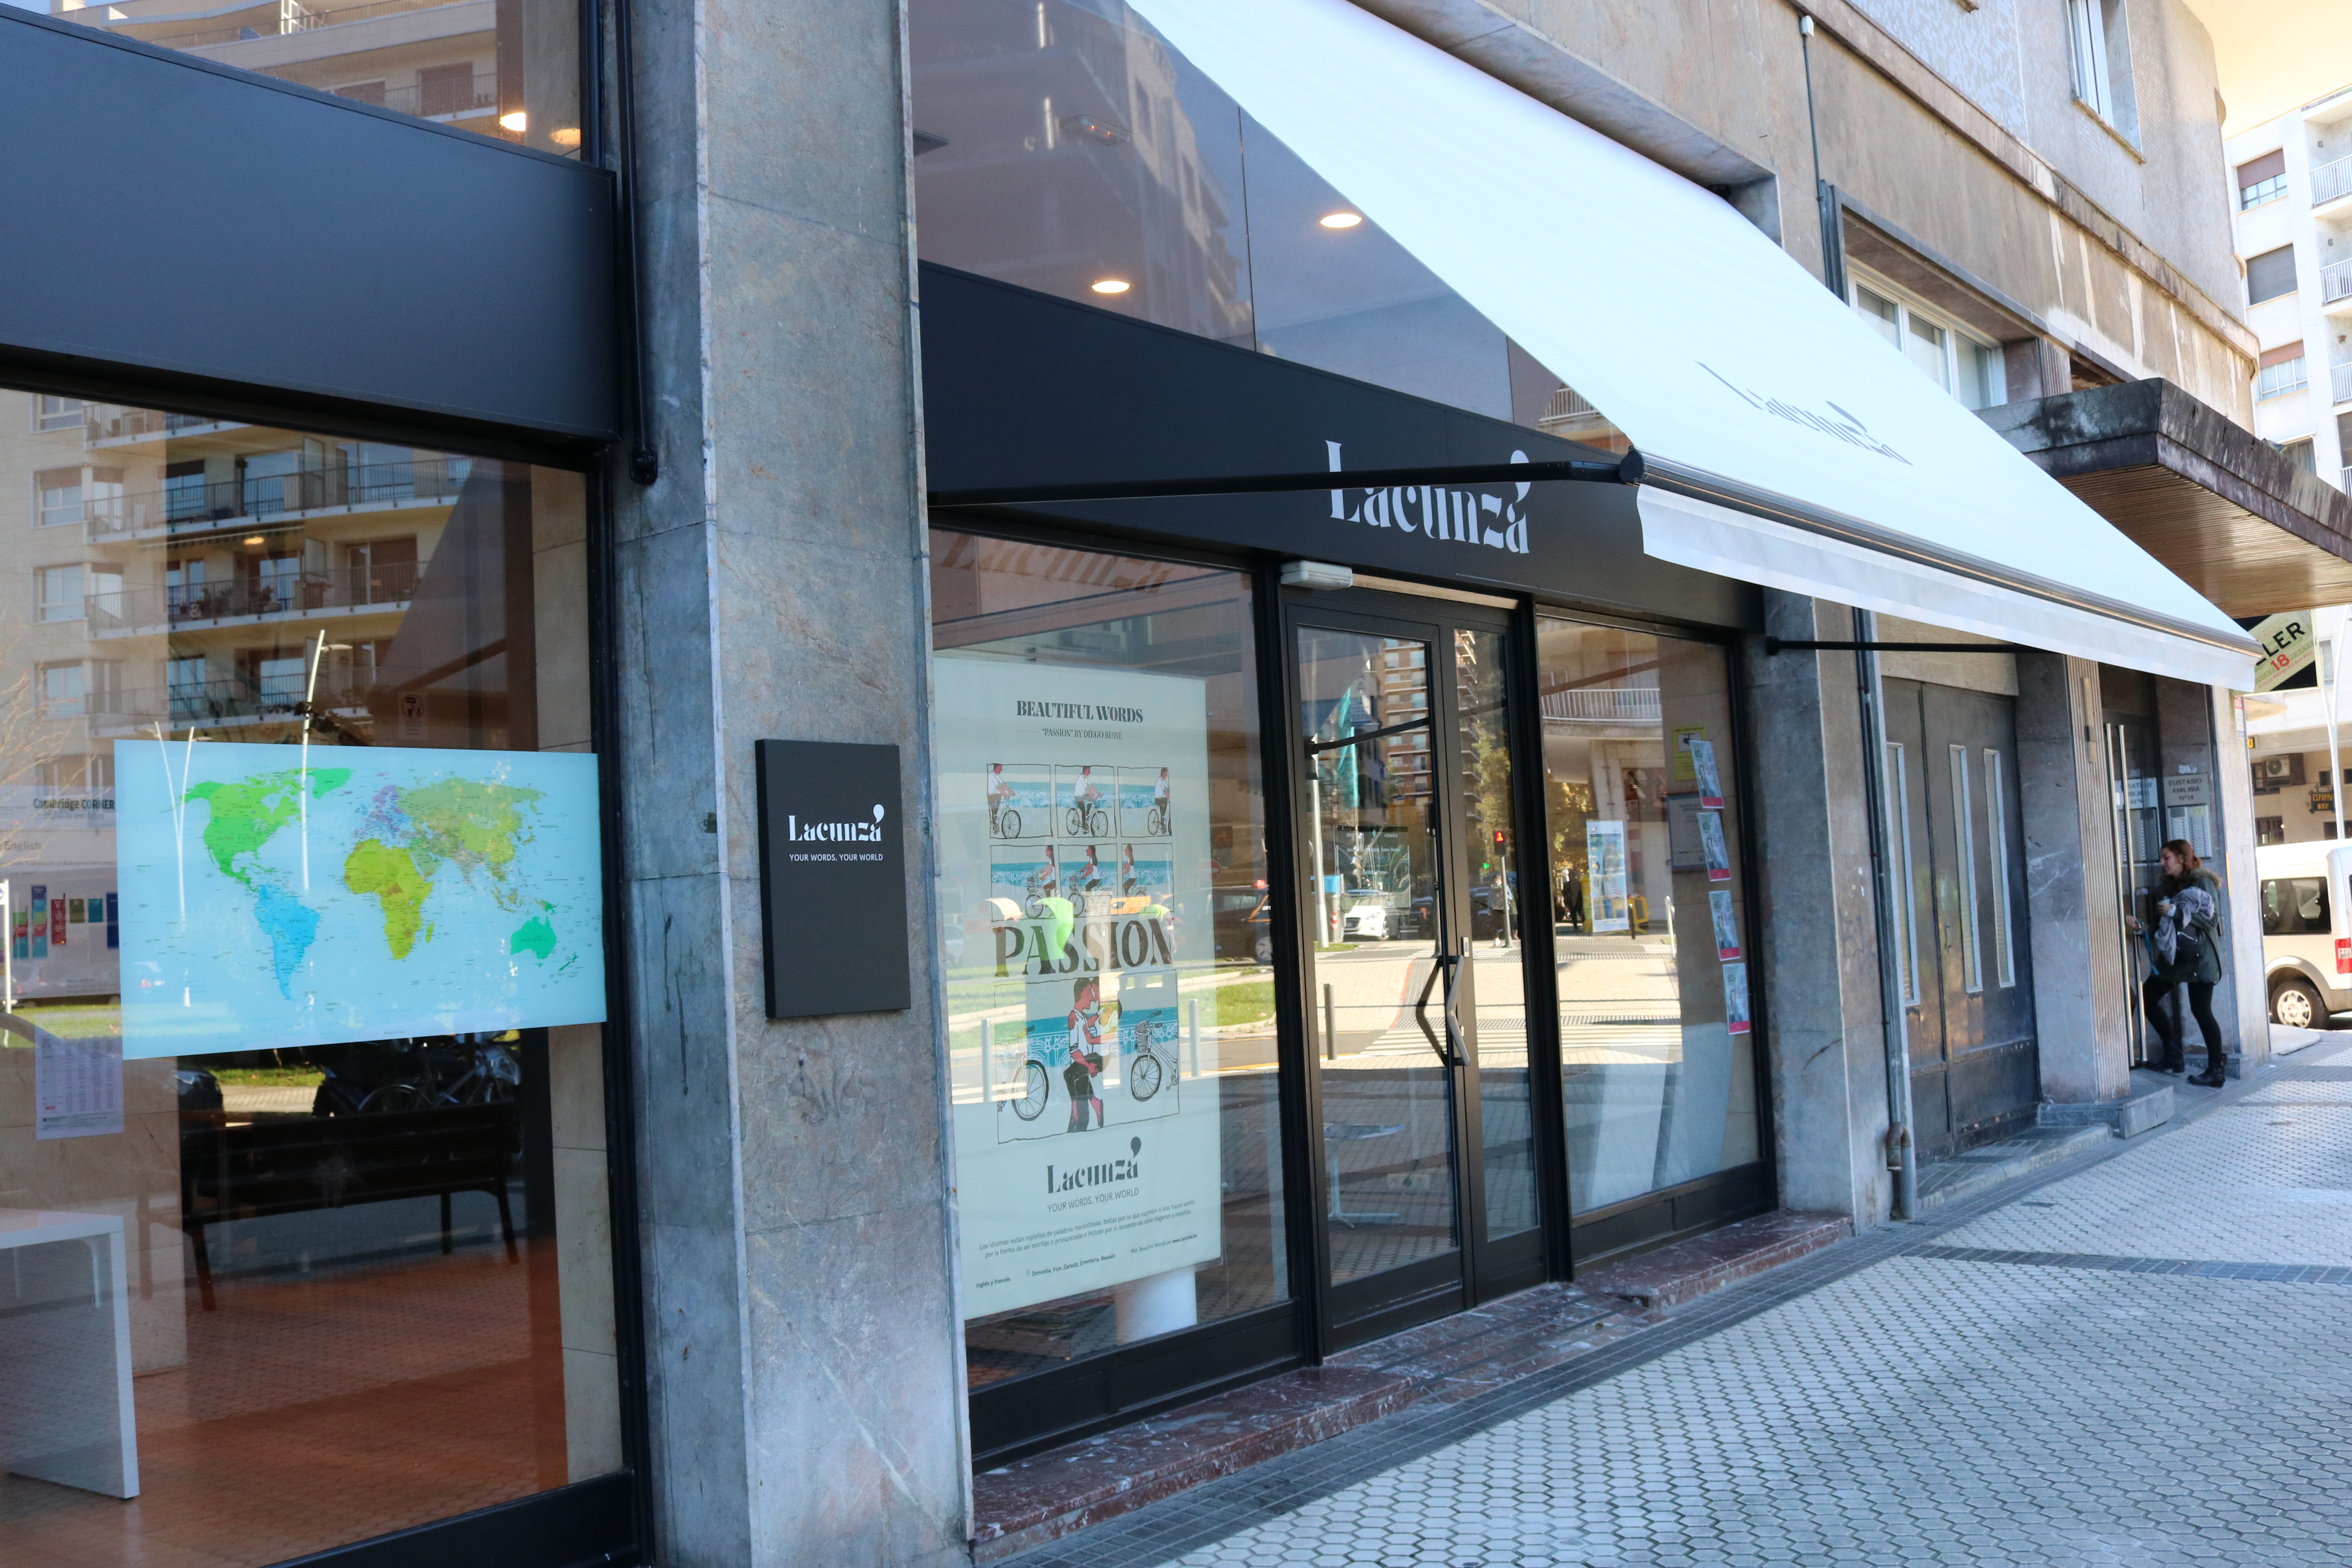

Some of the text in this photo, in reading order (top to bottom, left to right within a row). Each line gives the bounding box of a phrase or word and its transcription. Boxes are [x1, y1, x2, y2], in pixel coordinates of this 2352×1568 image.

[1325, 440, 1531, 554] Lacunza
[2270, 653, 2290, 671] 18
[1017, 700, 1143, 723] BEAUTIFUL WORDS
[1084, 730, 1104, 739] DIEGO
[1105, 730, 1122, 740] BESNÉ
[2169, 778, 2202, 786] EUSTASIO
[33, 799, 80, 811] Cambridge
[82, 800, 115, 809] CORNER
[788, 804, 885, 842] Lacunza
[4, 841, 41, 851] English
[992, 918, 1173, 977] PASSION
[1047, 1136, 1142, 1194] Lacunza
[1048, 1201, 1066, 1212] YOUR
[1095, 1192, 1113, 1203] YOUR
[1114, 1188, 1139, 1200] WORLD
[990, 1240, 1009, 1248] idiomas
[1011, 1236, 1024, 1244] están
[1026, 1233, 1045, 1242] repletos
[1054, 1227, 1073, 1237] palabras
[1141, 1209, 1157, 1217] expresan
[1000, 1247, 1015, 1256] forma
[1031, 1241, 1049, 1250] escritas
[1055, 1233, 1083, 1245] pronunciadas
[1088, 1229, 1104, 1238] incluso
[1118, 1222, 1137, 1230] recuerdo
[1154, 1214, 1171, 1223] llegaron
[1139, 1243, 1154, 1252] Beautiful
[1172, 1234, 1197, 1244] www.lacunza.es
[1101, 1253, 1115, 1261] Beasain
[995, 1276, 1010, 1285] francés
